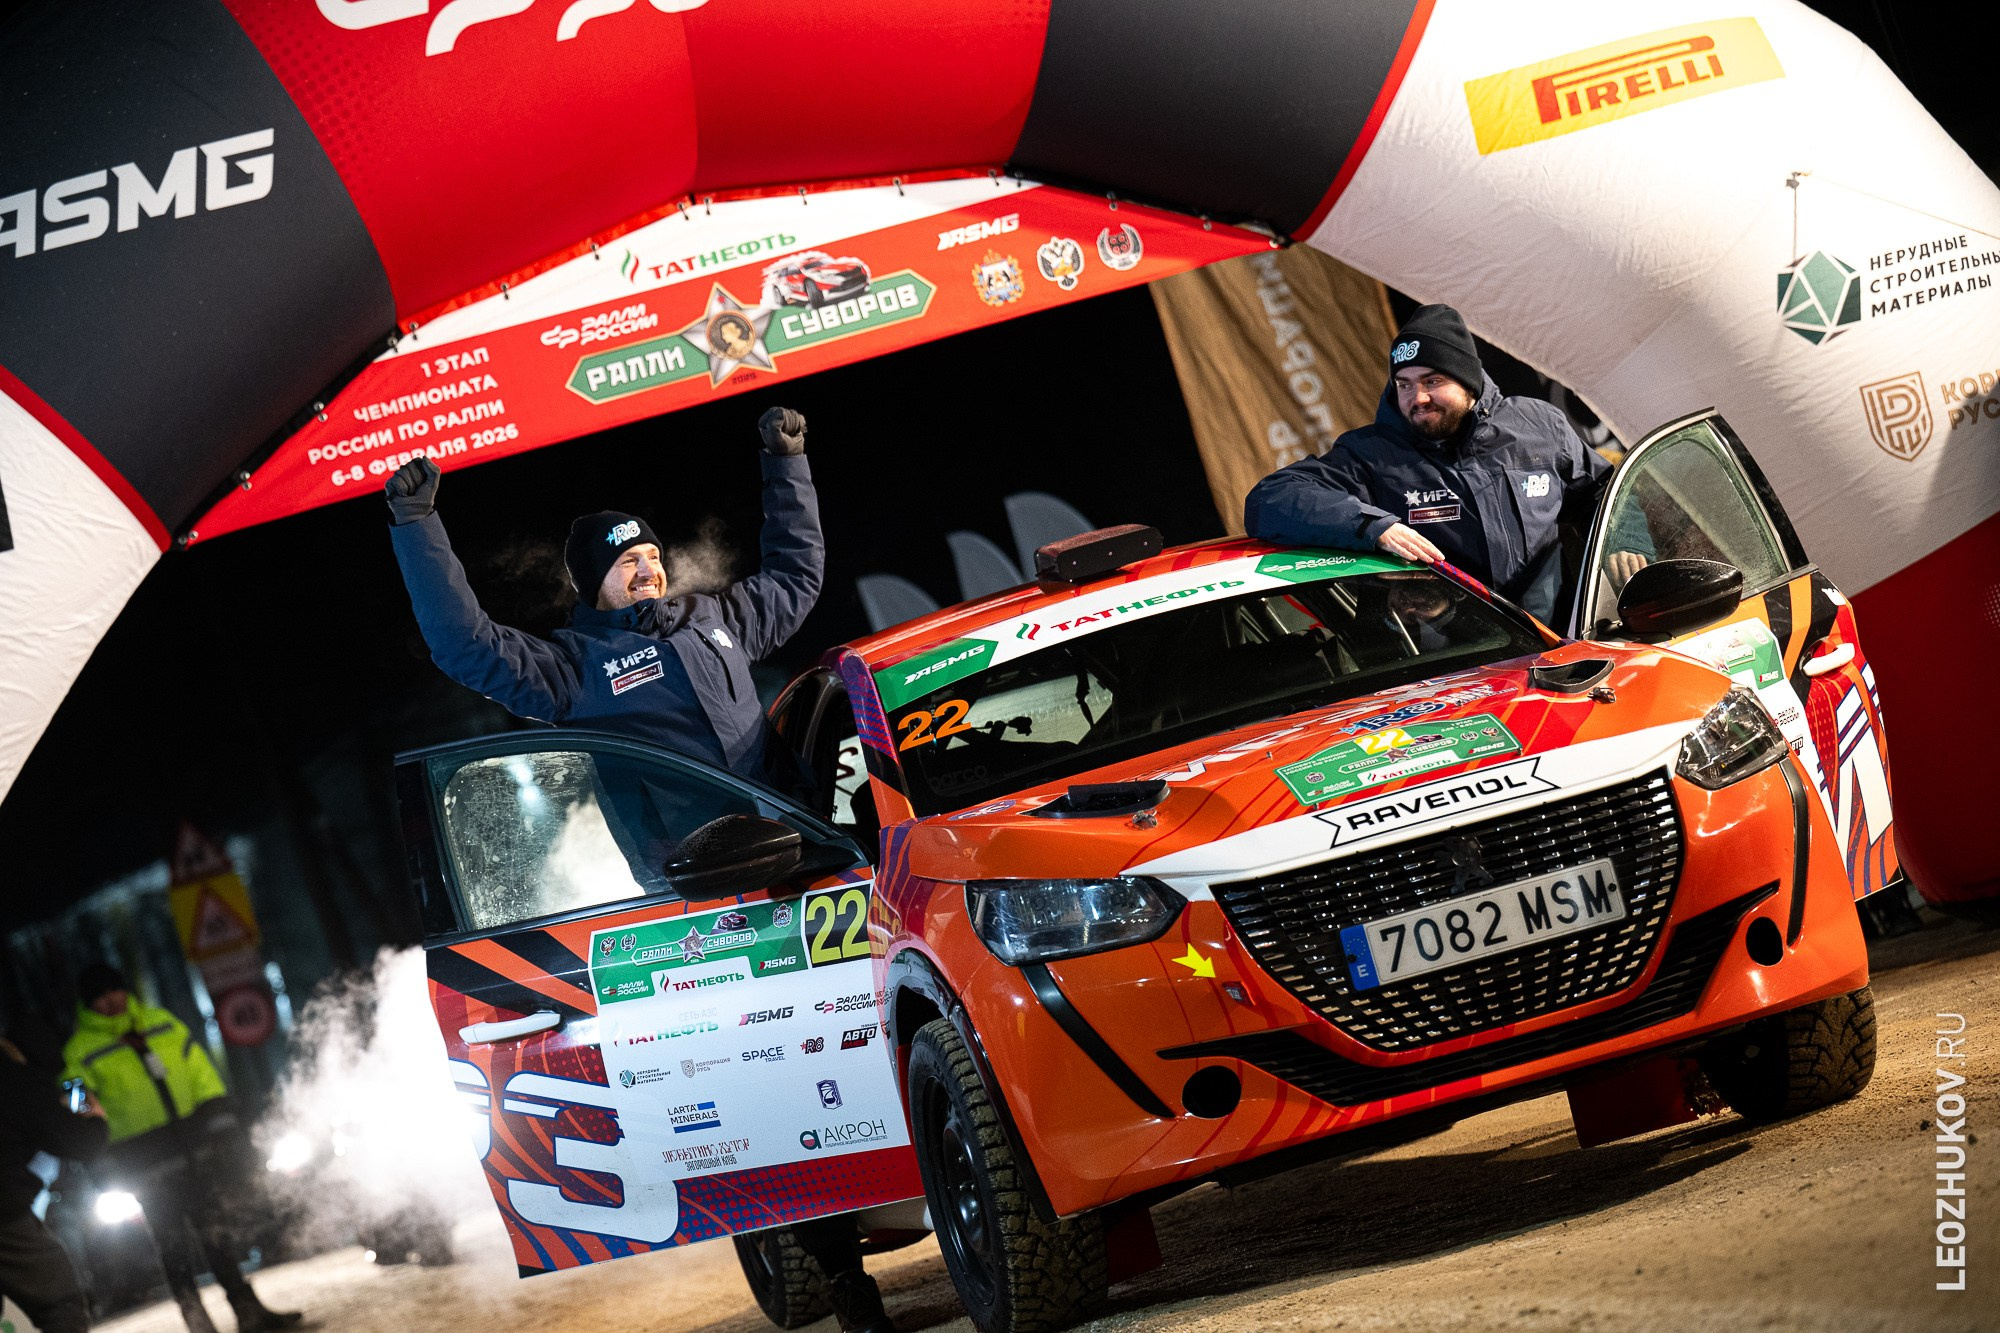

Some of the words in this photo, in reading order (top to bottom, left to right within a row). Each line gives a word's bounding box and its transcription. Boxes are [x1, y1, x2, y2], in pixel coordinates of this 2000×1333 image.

[1531, 35, 1725, 125] PIRELLI
[942, 213, 1020, 249] ASMG
[648, 232, 797, 279] ТАТНЕФТЬ
[1869, 234, 1968, 271] НЕРУДНЫЕ
[1871, 274, 1992, 318] МАТЕРИАЛЫ
[580, 313, 658, 345] РОССИИ
[581, 303, 647, 331] РАЛЛИ
[585, 345, 687, 393] РАЛЛИ
[780, 283, 919, 341] СУВОРОВ
[420, 362, 432, 378] 1
[436, 346, 490, 375] ЭТАП
[1394, 340, 1421, 365] R8
[353, 373, 498, 423] ЧЕМПИОНАТА
[307, 428, 394, 465] РОССИИ
[397, 419, 430, 441] ПО
[432, 399, 505, 431] РАЛЛИ
[331, 465, 366, 487] 6-8
[470, 423, 519, 450] 2026
[611, 520, 641, 546] R8
[1050, 578, 1246, 633] ТАТНЕФТЬ
[620, 645, 659, 670] ИРЗ
[906, 644, 986, 685] ASMG
[897, 699, 972, 752] 22
[1357, 701, 1447, 731] R8
[1347, 757, 1379, 771] РАЛЛИ
[1410, 739, 1454, 755] СУВОРОВ
[1354, 728, 1417, 755] 22
[1472, 741, 1506, 754] ASMG
[1381, 759, 1452, 780] ТАТНЕФТЬ
[1345, 773, 1528, 831] RAVENOL
[806, 889, 872, 963] 22
[1379, 900, 1509, 974] 7082
[1517, 870, 1613, 935] MSM
[641, 946, 673, 961] РАЛЛИ
[706, 932, 752, 949] СУВОРОВ
[761, 955, 797, 970] ASMG
[1356, 964, 1369, 979] E
[617, 980, 644, 991] РАЛЛИ
[617, 985, 649, 996] РОССИИ
[673, 972, 745, 993] ТАТНЕФТЬ
[835, 1000, 877, 1014] РОССИИ
[836, 992, 871, 1005] РАЛЛИ
[742, 1006, 794, 1025] ASMG
[804, 1037, 824, 1054] R8
[843, 1027, 876, 1042] АВТО
[742, 1046, 785, 1062] SPACE
[764, 1055, 786, 1063] TRAVEL
[667, 1104, 696, 1116] LARTA
[670, 1110, 719, 1125] MINERALS
[824, 1118, 887, 1143] АКРОН
